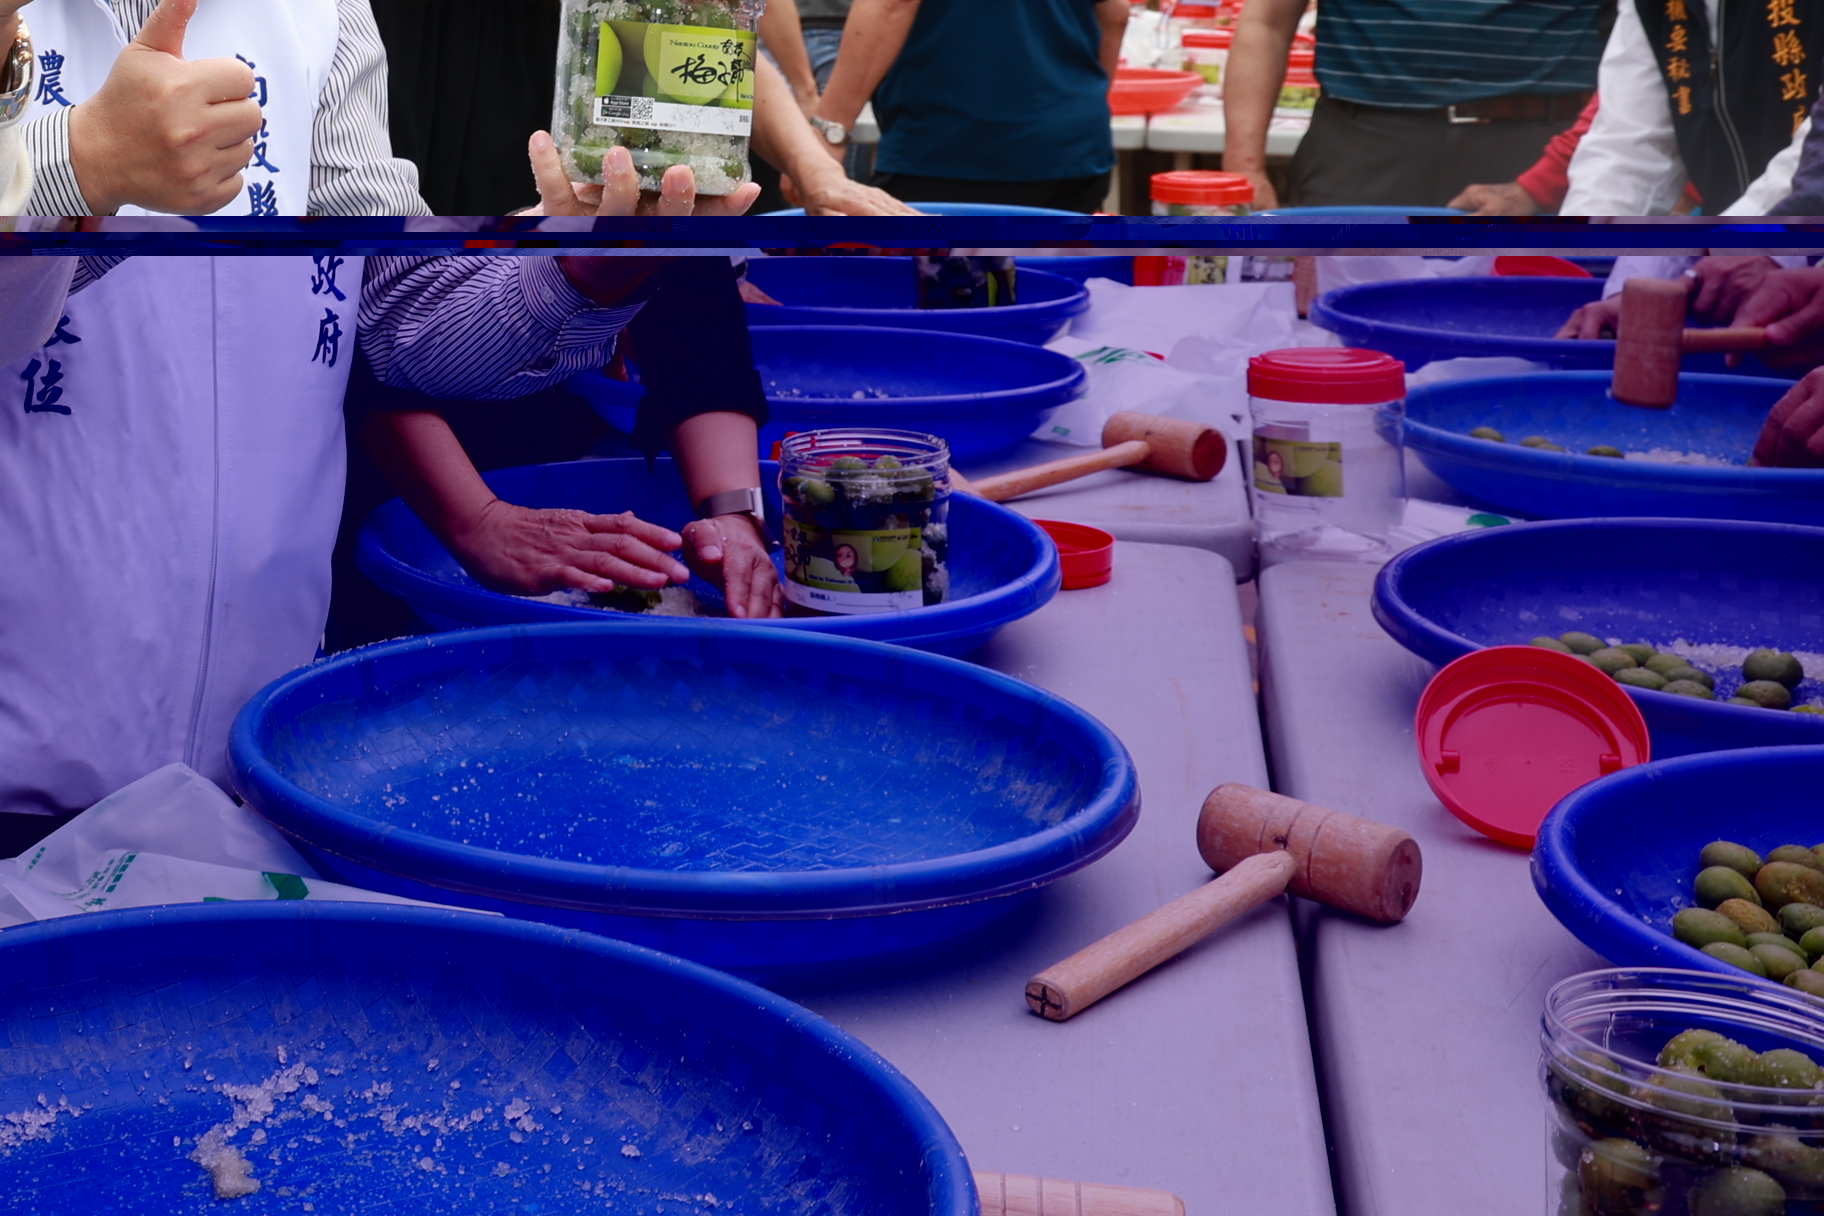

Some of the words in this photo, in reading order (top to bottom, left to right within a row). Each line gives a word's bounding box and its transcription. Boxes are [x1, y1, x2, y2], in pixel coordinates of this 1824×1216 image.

[669, 39, 696, 48] Nantou
[696, 41, 720, 51] County
[34, 49, 72, 107] 農
[311, 255, 347, 368] 政府
